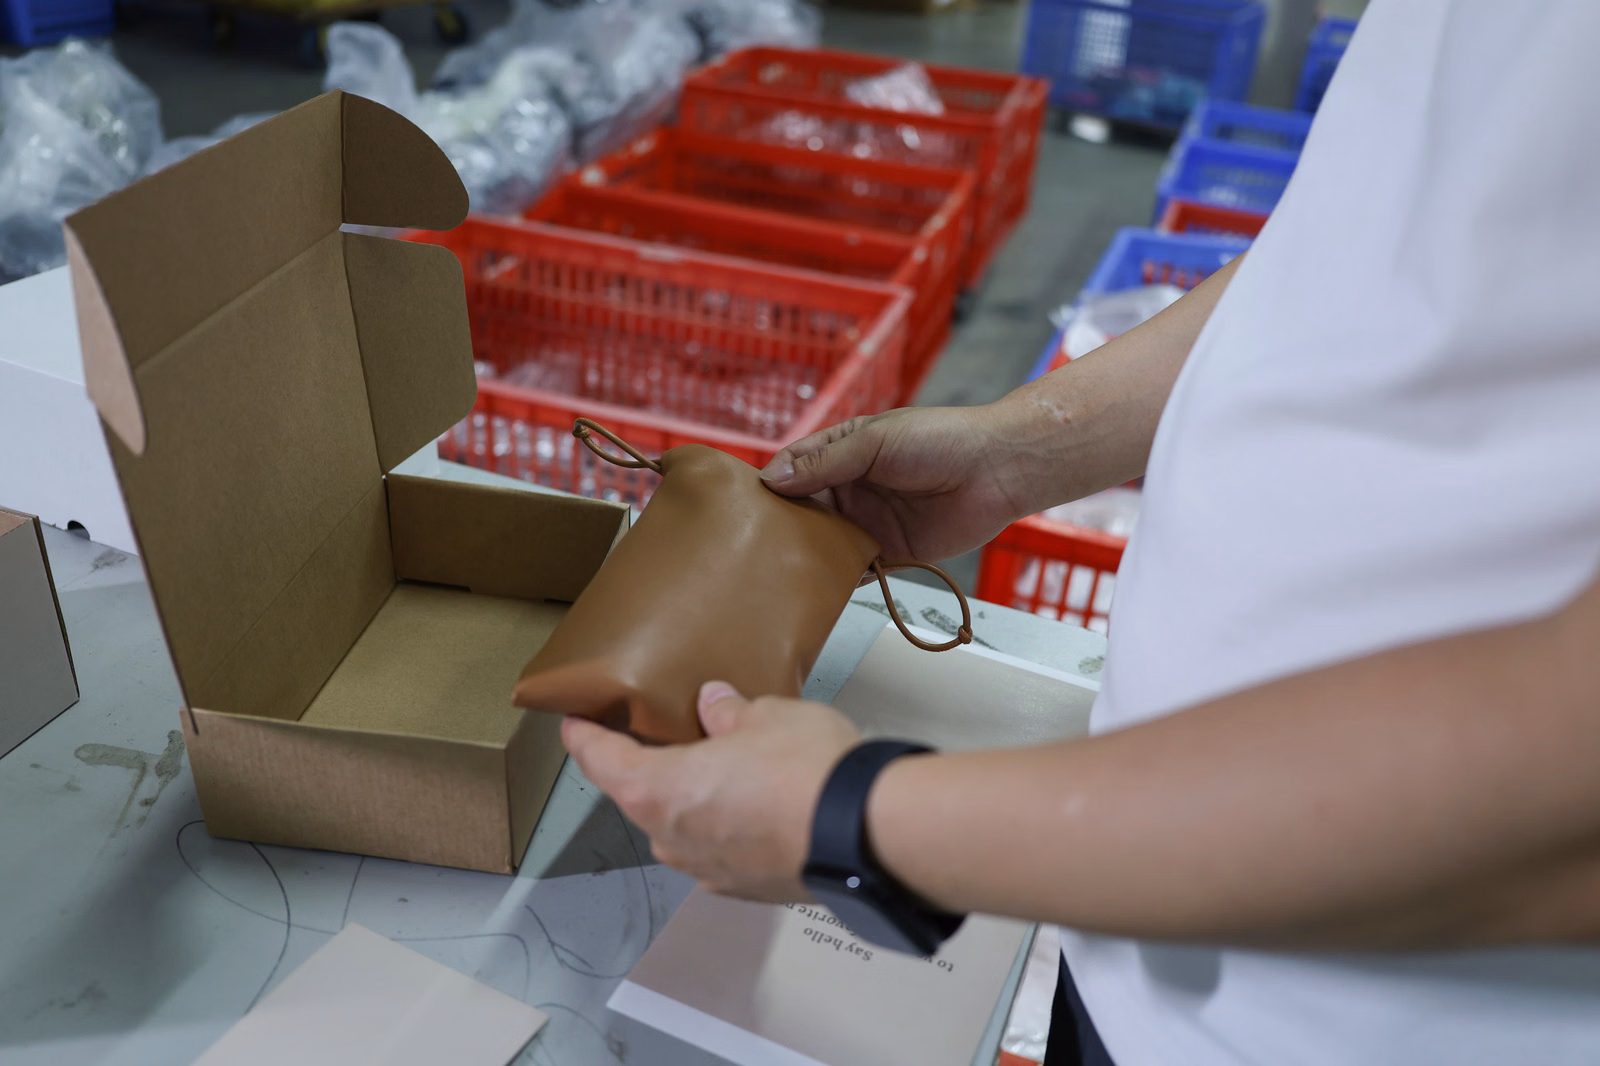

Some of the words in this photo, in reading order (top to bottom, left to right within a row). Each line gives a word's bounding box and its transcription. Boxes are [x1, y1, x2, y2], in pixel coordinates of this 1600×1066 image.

[803, 927, 843, 951] hello
[844, 942, 874, 961] Say
[937, 960, 954, 972] to
